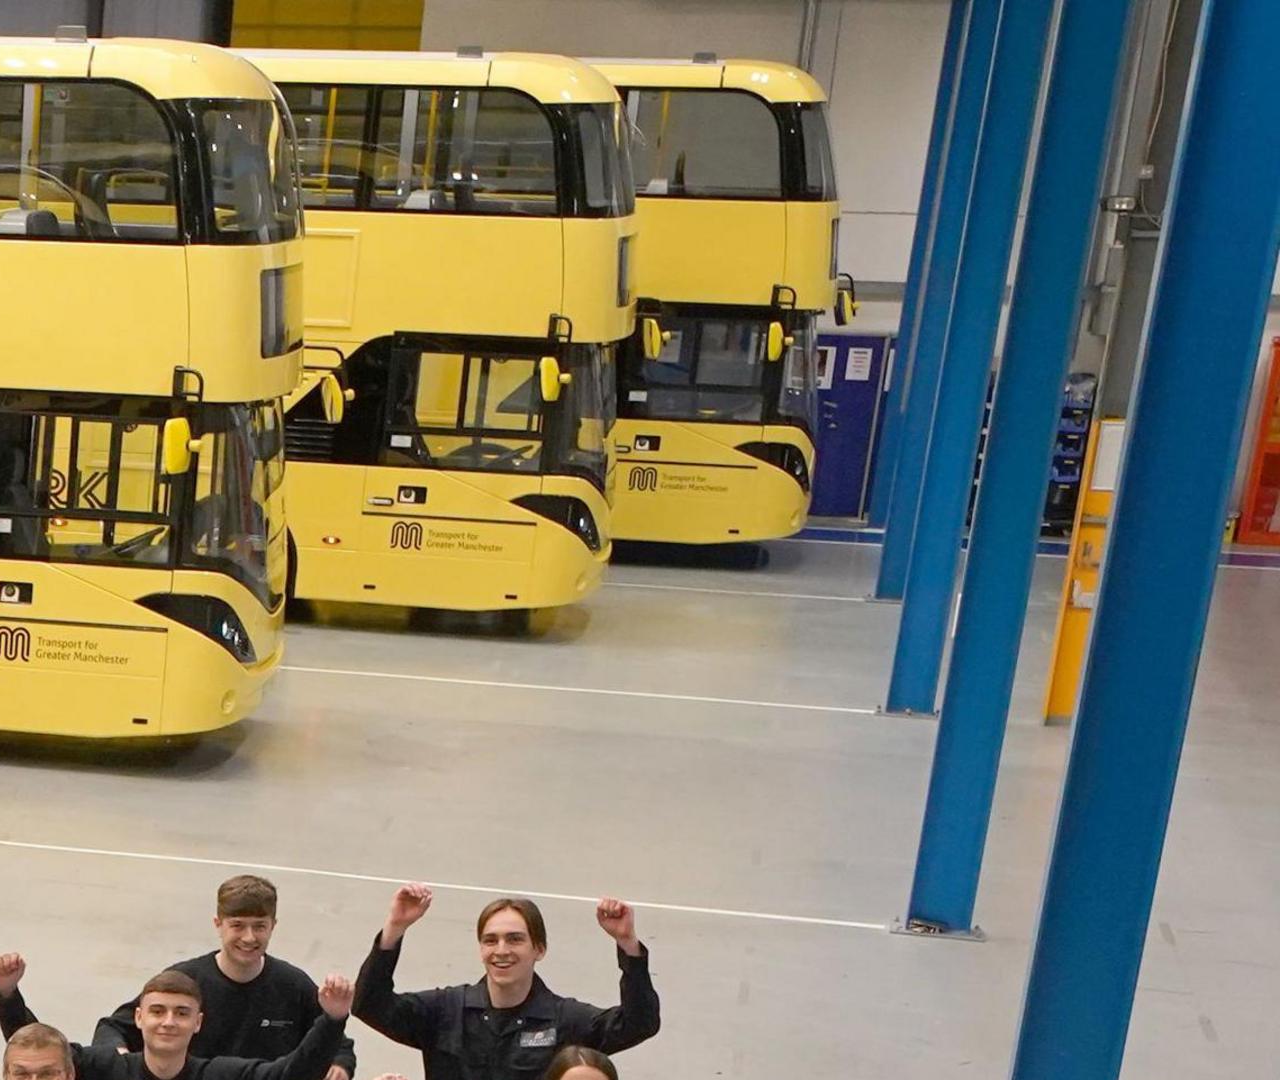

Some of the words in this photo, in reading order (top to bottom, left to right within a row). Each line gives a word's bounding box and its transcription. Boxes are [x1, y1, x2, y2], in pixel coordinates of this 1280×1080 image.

[428, 529, 465, 540] Transport
[426, 540, 455, 549] Greater
[458, 542, 503, 552] Manchester
[37, 636, 82, 649] Transport
[84, 640, 98, 650] for
[35, 649, 71, 661] Greater
[74, 653, 129, 665] Manchester
